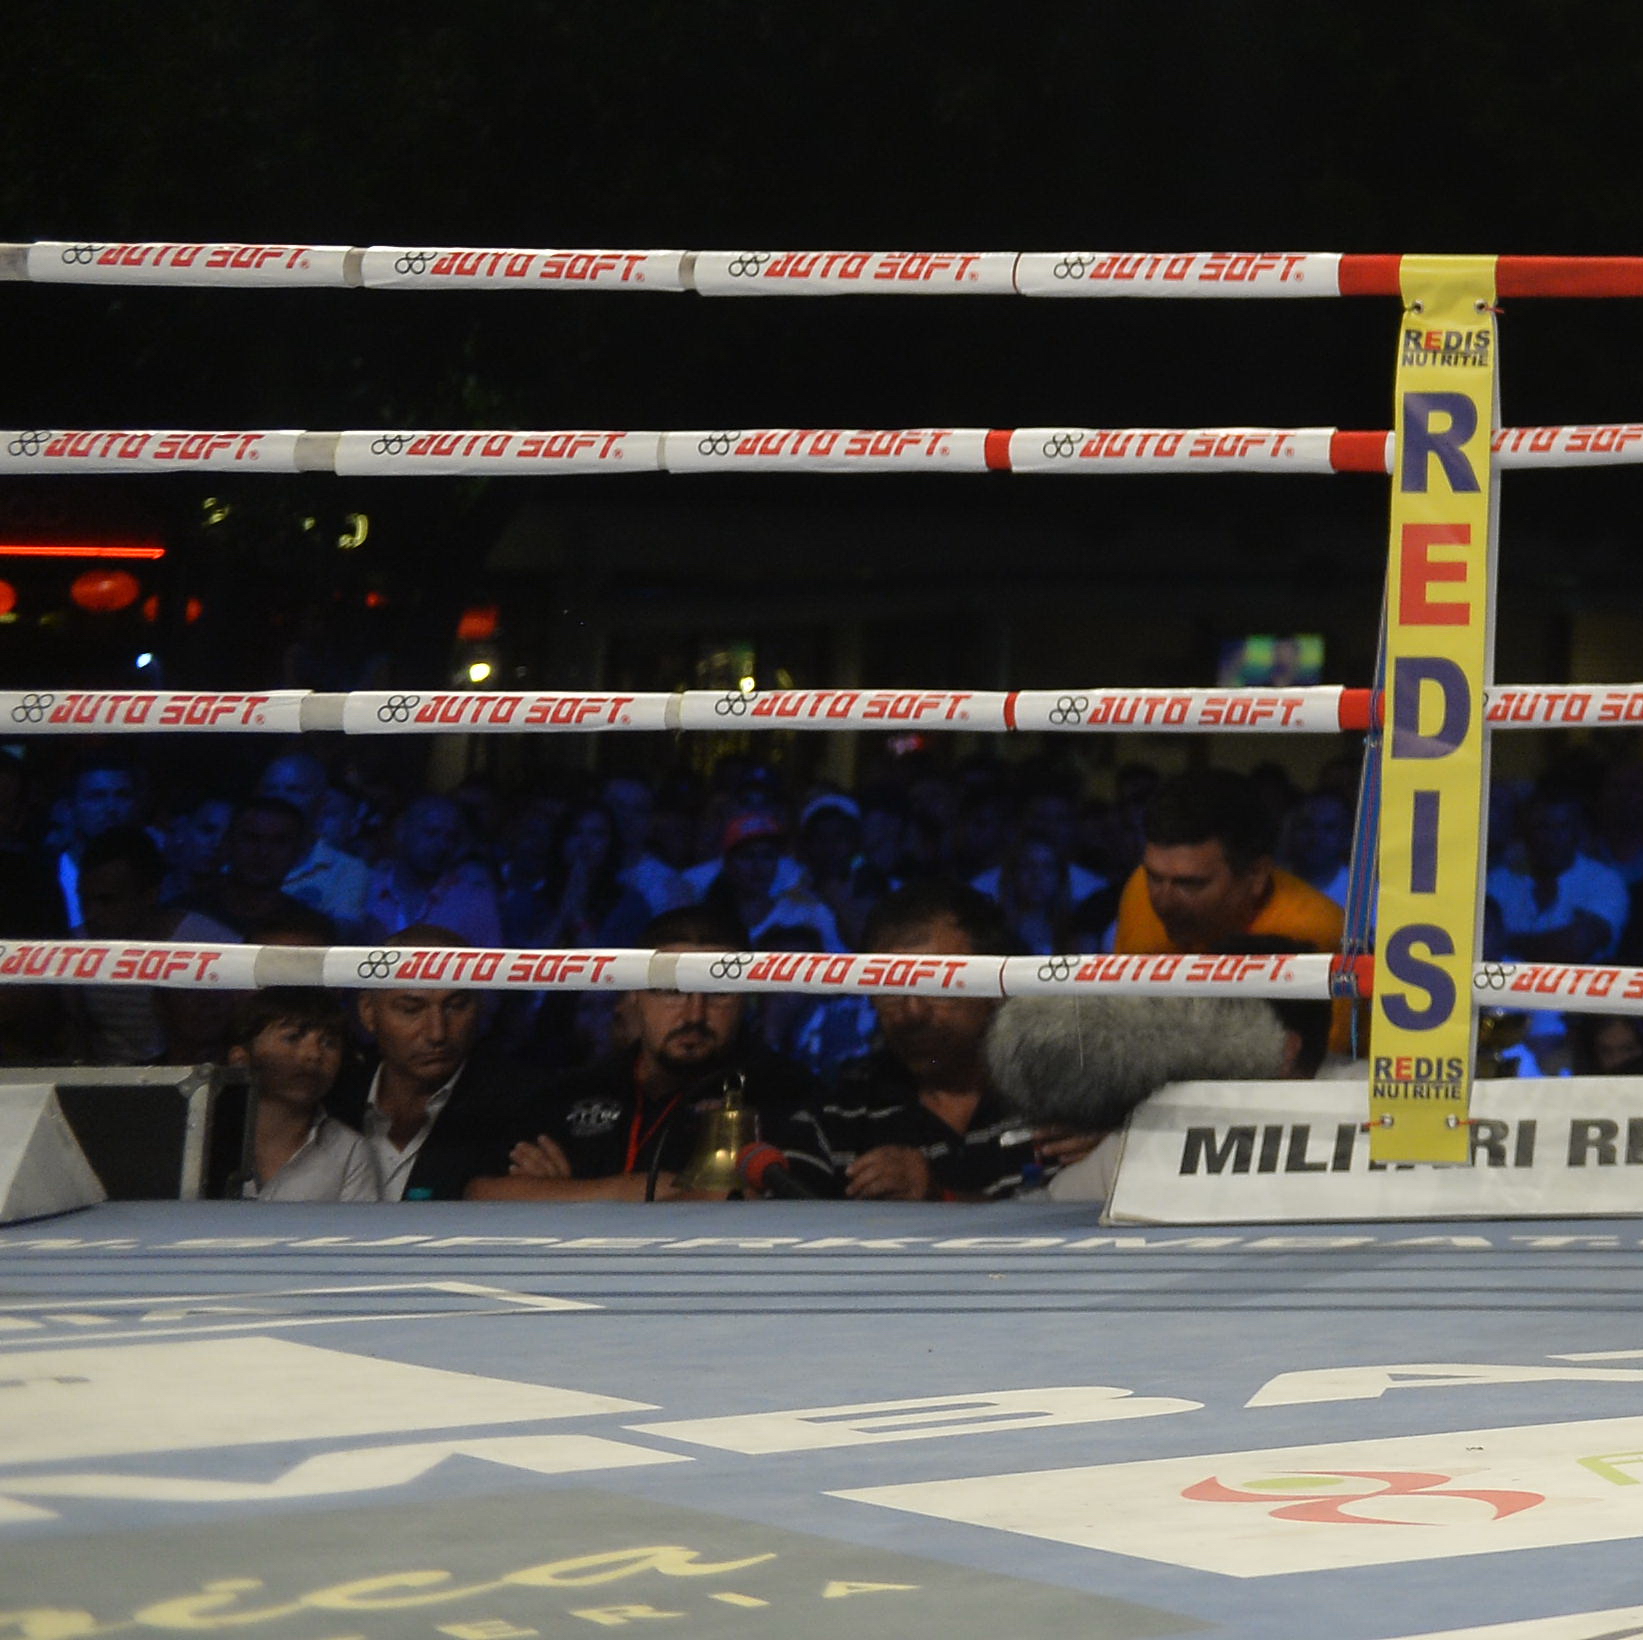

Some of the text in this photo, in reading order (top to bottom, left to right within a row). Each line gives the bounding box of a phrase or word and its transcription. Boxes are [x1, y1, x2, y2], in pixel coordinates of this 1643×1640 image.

[431, 252, 539, 277] AUTO
[764, 253, 872, 280] AUTO
[1089, 254, 1197, 281] AUTO
[1404, 329, 1491, 351] REDIS
[1402, 350, 1489, 367] NUTRITIE
[44, 432, 152, 458] AUTO
[407, 433, 513, 457] AUTO
[735, 430, 842, 456] AUTO
[1080, 431, 1185, 458] AUTO
[1487, 426, 1562, 453] UTO
[50, 694, 157, 724] AUTO
[415, 695, 524, 724] AUTO
[752, 691, 861, 718] AUTO
[1088, 696, 1192, 725] AUTO
[1381, 392, 1482, 1031] REDIS
[1487, 693, 1592, 722] AUTO
[395, 951, 506, 982] AUTO
[747, 954, 858, 984] AUTO
[1074, 952, 1184, 982] AUTO
[1511, 966, 1621, 997] AUTO
[1375, 1056, 1464, 1080] REDIS
[1373, 1080, 1462, 1099] NUTRITIE
[1178, 1119, 1537, 1175] MILIRI
